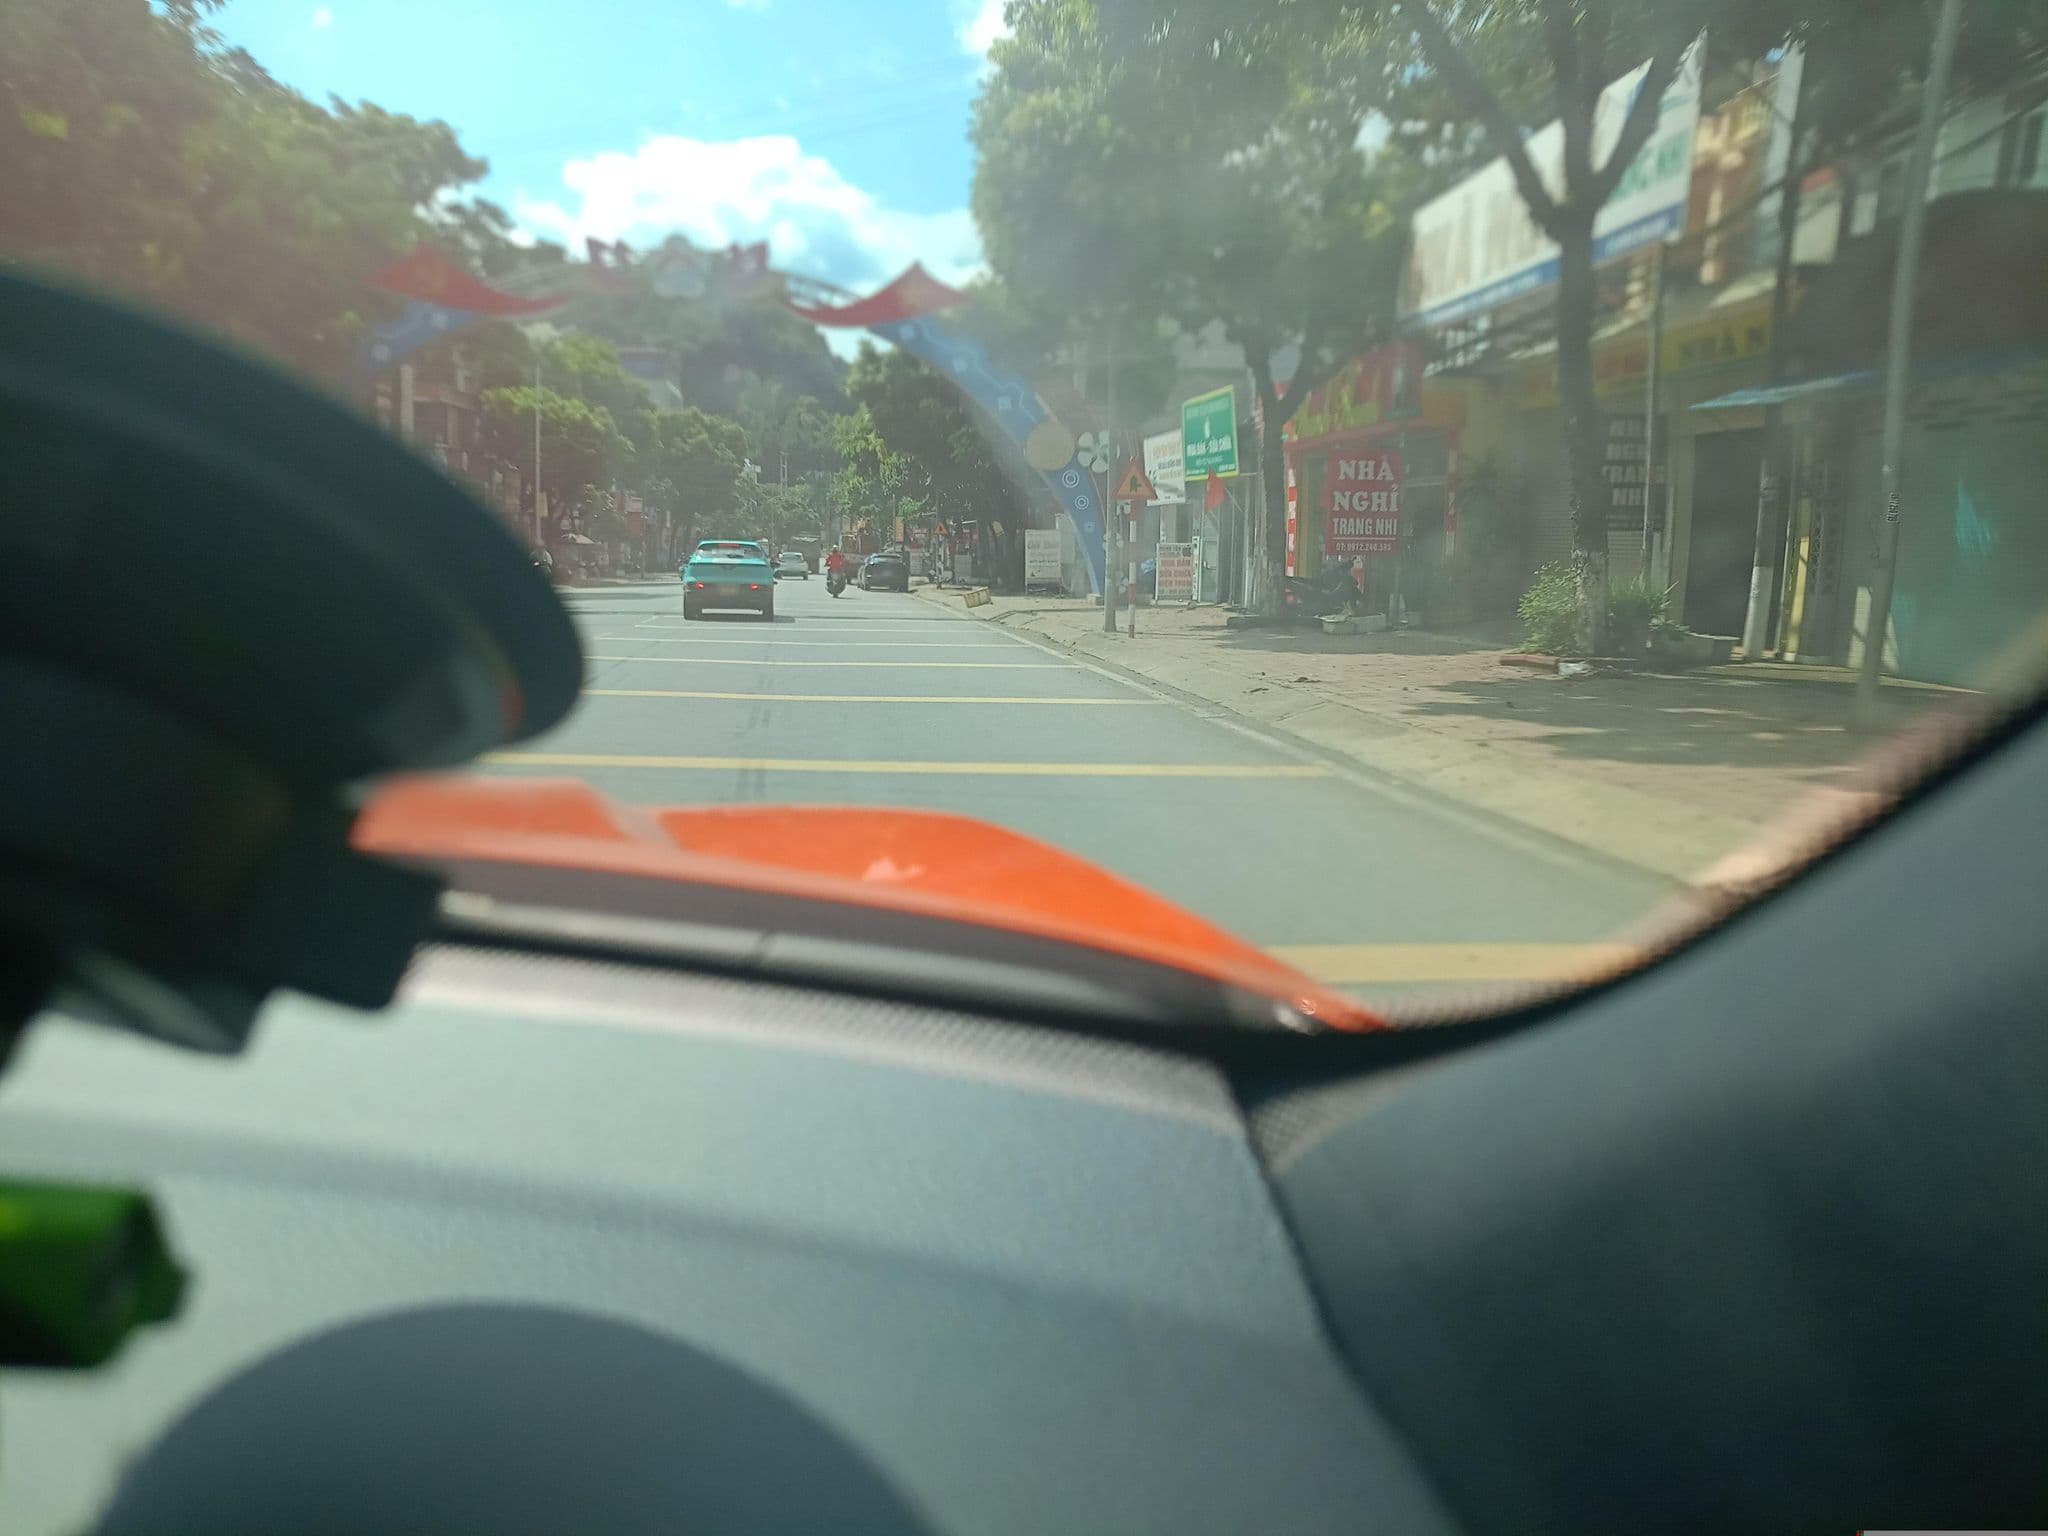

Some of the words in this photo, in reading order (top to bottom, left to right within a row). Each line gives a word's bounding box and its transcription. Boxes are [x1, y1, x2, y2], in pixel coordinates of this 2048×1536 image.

[1332, 483, 1400, 512] NGHỈ
[1332, 517, 1373, 535] TRANG
[1375, 517, 1398, 535] NHI
